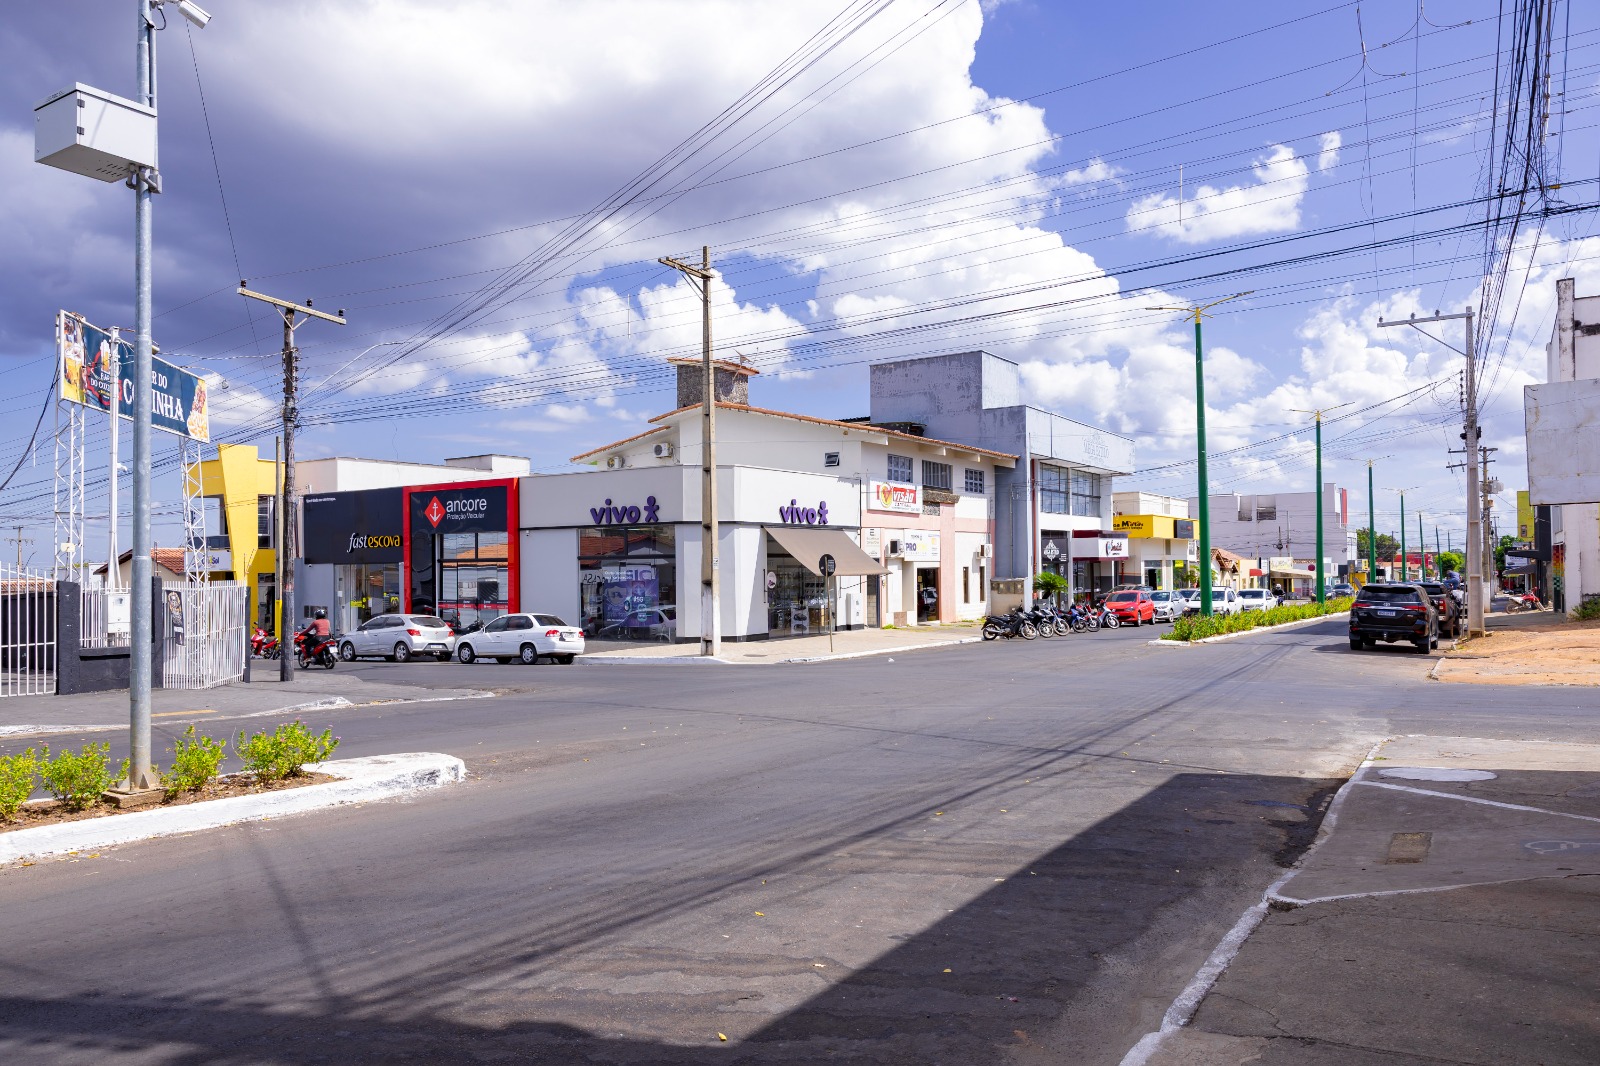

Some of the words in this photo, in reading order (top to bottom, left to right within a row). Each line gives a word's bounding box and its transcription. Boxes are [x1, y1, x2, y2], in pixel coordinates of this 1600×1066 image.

[158, 373, 168, 389] DO
[123, 378, 185, 422] CINHA
[446, 498, 487, 512] ancore
[590, 498, 641, 525] vivo
[779, 499, 817, 525] vivo
